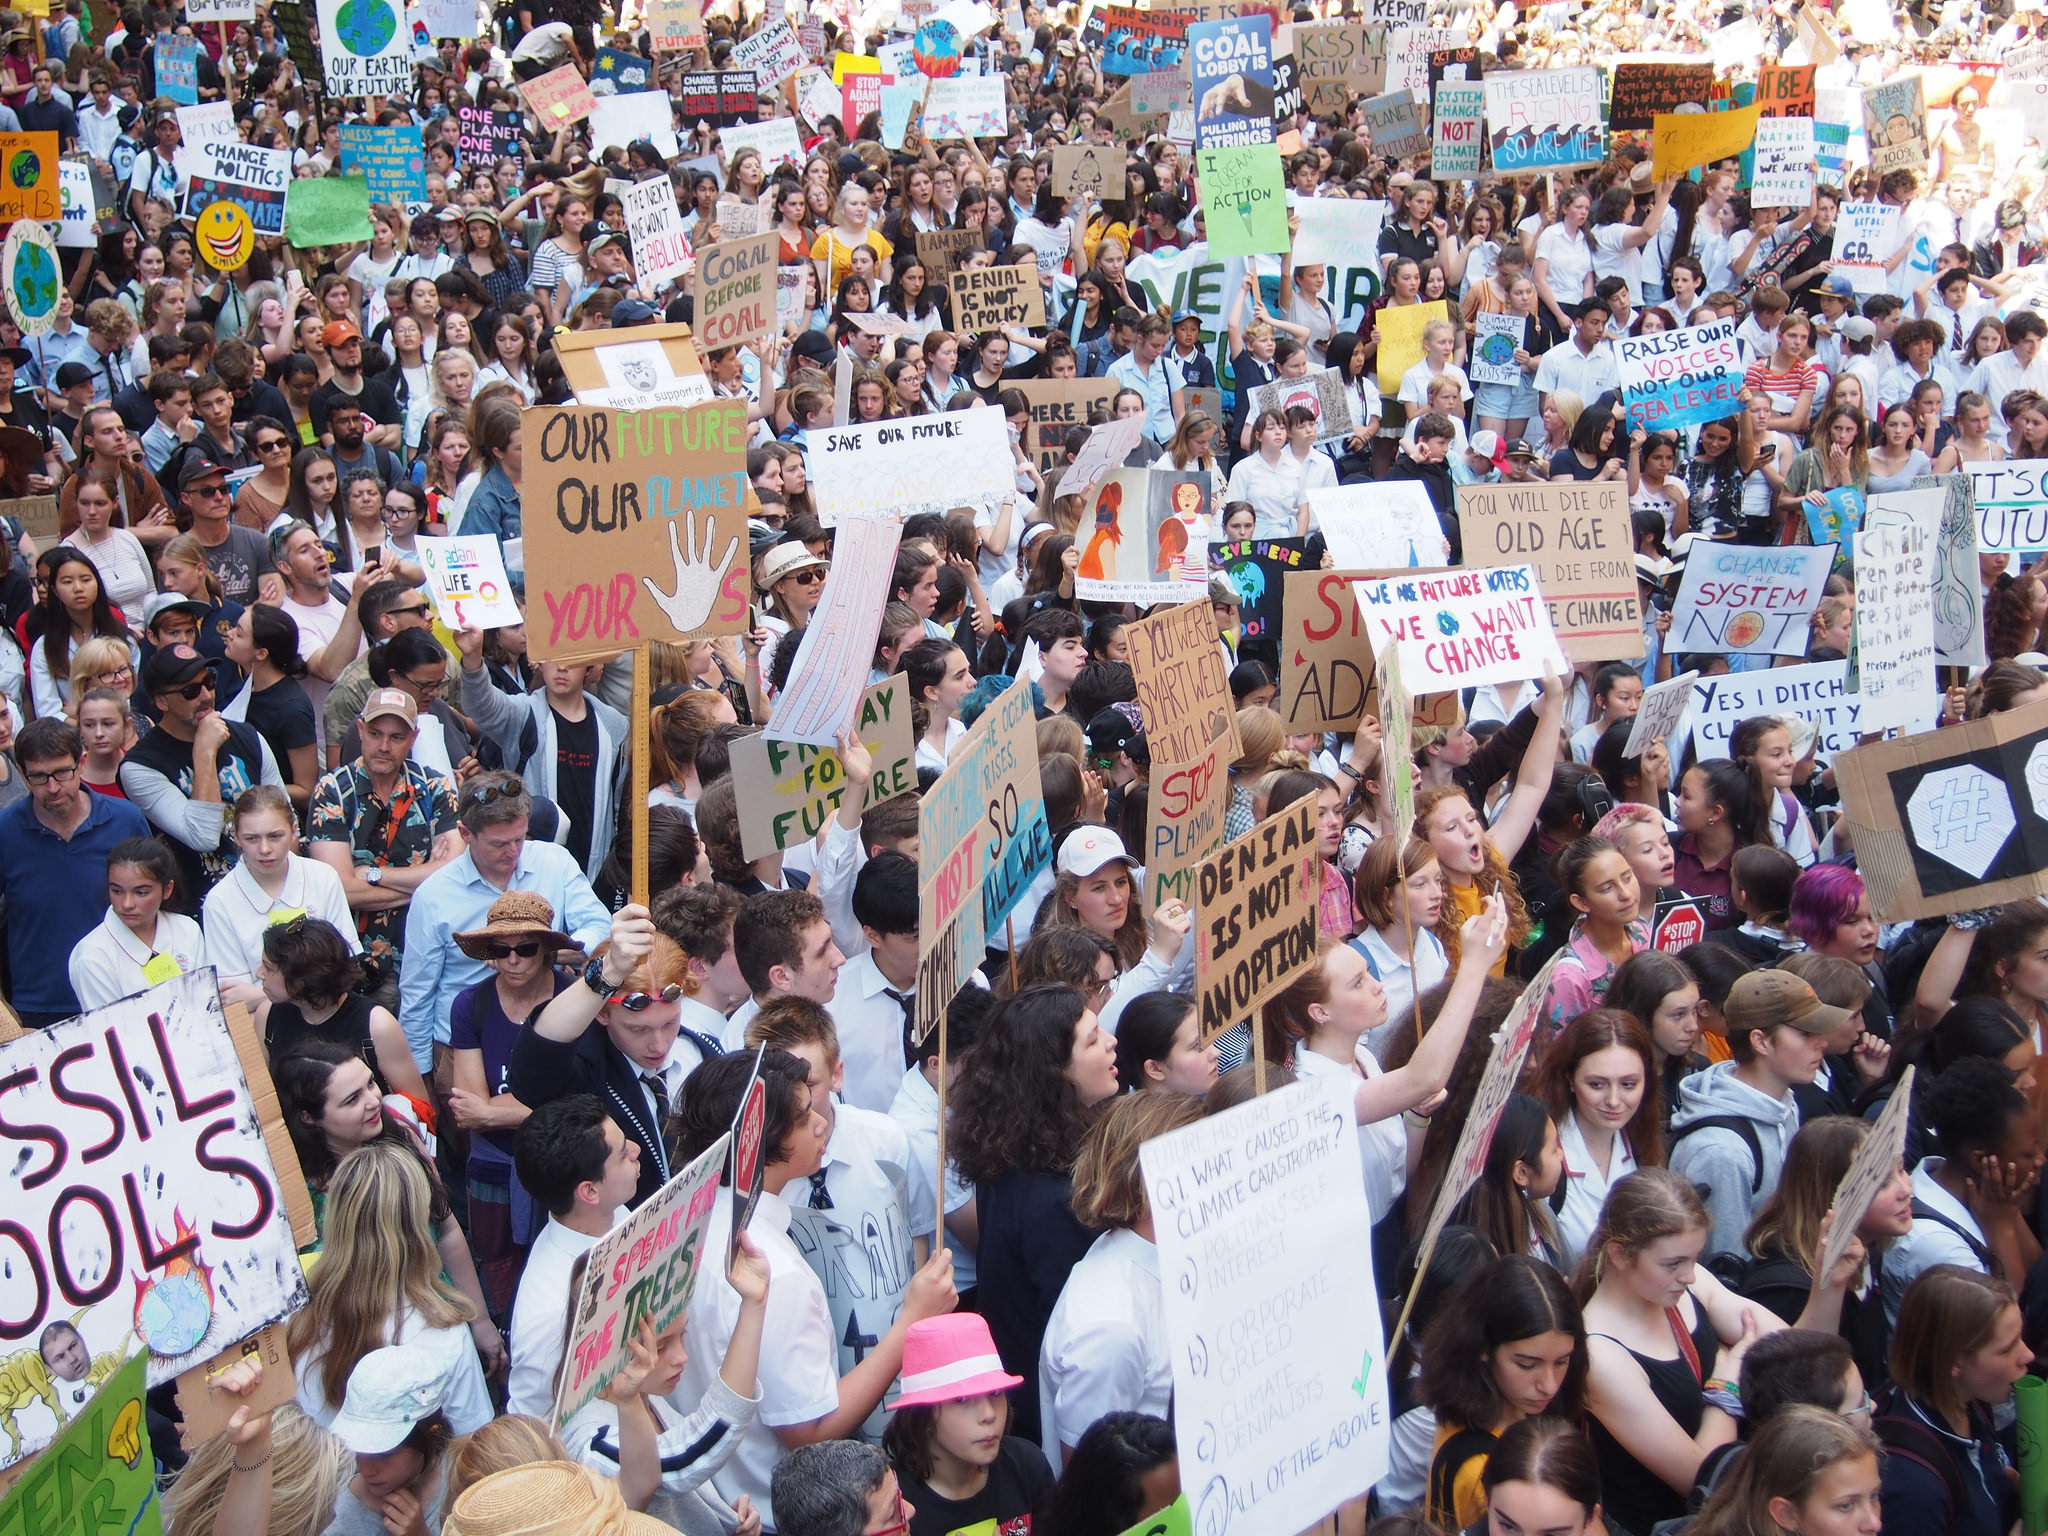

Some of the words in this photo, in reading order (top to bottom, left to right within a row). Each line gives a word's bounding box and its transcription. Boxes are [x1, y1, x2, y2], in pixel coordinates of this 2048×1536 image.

[1111, 6, 1135, 19] The
[1374, 0, 1427, 22] REPORT
[736, 38, 761, 61] SHUT
[762, 20, 789, 42] DOWN
[1109, 22, 1156, 48] rising
[1221, 23, 1239, 34] THE
[656, 34, 703, 49] FUTURE
[1106, 39, 1127, 56] so
[1132, 44, 1162, 64] are
[1195, 32, 1267, 62] COAL
[1301, 31, 1354, 59] KISS
[1362, 28, 1386, 51] MY
[333, 57, 357, 75] OUR
[366, 54, 411, 75] EARTH
[762, 51, 783, 68] NOT
[1197, 59, 1248, 78] LOBBY
[1253, 55, 1268, 70] IS
[1619, 64, 1661, 79] Scott
[327, 78, 353, 97] OUR
[359, 77, 411, 94] FUTURE
[683, 85, 718, 95] POLITICS
[684, 75, 716, 85] CHANGE
[721, 82, 756, 93] POLITICS
[722, 74, 754, 83] CHANGE
[856, 77, 881, 89] STOP
[1878, 83, 1905, 97] REAL
[1311, 83, 1345, 105] ASS
[1436, 91, 1482, 103] SYSTEM
[458, 107, 493, 124] ONE
[1367, 103, 1415, 128] PLANET
[1435, 104, 1480, 117] CHANGE
[1510, 95, 1591, 126] RISING
[340, 128, 373, 142] UNLESS
[460, 123, 521, 141] PLANET
[1201, 120, 1247, 136] PULLING
[1249, 116, 1271, 129] THE
[459, 136, 492, 152] ONE
[1202, 130, 1271, 150] STRINGS
[1433, 145, 1479, 158] CLIMATE
[1505, 137, 1527, 163] SO
[1533, 132, 1563, 161] ARE
[1570, 130, 1599, 160] WE
[204, 143, 270, 167] CHANGE
[1433, 159, 1477, 171] CHANGE
[1884, 146, 1915, 163] 100%
[1783, 163, 1810, 172] NEED
[1754, 180, 1805, 189] MOTHER
[34, 189, 54, 217] B
[1213, 189, 1271, 210] ACTION
[703, 242, 770, 286] CORAL
[954, 269, 1027, 291] DENIAL
[704, 273, 761, 316] BEFORE
[960, 293, 979, 310] IS
[983, 288, 1018, 307] NOT
[703, 302, 767, 346] COAL
[961, 313, 974, 329] A
[977, 303, 1029, 327] POLICY
[1478, 315, 1521, 326] CLIMATE
[1484, 324, 1514, 333] CHANGE
[1621, 332, 1690, 363] RAISE
[1697, 324, 1735, 343] OUR
[1471, 362, 1500, 380] EXISTS
[1643, 342, 1735, 379] VOICES
[1628, 376, 1668, 398] NOT
[1679, 364, 1728, 388] OUR
[608, 391, 634, 407] Here
[636, 390, 648, 403] in
[654, 385, 693, 402] support
[695, 384, 705, 395] of
[1629, 401, 1669, 424] SEA
[1672, 381, 1741, 410] LEVEL
[541, 412, 610, 463] OUR
[616, 409, 746, 459] FUTURE
[826, 434, 862, 452] SAVE
[878, 427, 904, 444] OUR
[912, 420, 963, 440] FUTURE
[557, 478, 642, 534] OUR
[647, 472, 747, 519] PLANET
[1461, 493, 1497, 517] YOU
[1508, 492, 1549, 512] WILL
[1559, 491, 1590, 511] DIE
[1600, 491, 1616, 510] OF
[1496, 521, 1545, 554] OLD
[1558, 517, 1606, 550] AGE
[443, 547, 477, 564] adani
[1212, 541, 1252, 565] LIVE
[1257, 542, 1302, 566] HERE
[1717, 553, 1806, 575] CHANGE
[443, 573, 471, 592] LIFE
[1556, 563, 1581, 581] DIE
[1590, 561, 1630, 579] FROM
[1745, 575, 1774, 584] THE
[1364, 583, 1392, 604] WE
[1396, 582, 1417, 602] ARE
[1419, 574, 1482, 602] FUTURE
[1484, 568, 1529, 593] VOTERS
[1695, 582, 1808, 609] SYSTEM
[543, 573, 640, 646] YOUR
[720, 567, 748, 622] S
[1566, 599, 1637, 627] CHANGE
[1380, 616, 1425, 642] WE
[1472, 597, 1537, 636] WANT
[1682, 609, 1809, 649] NOT
[1127, 627, 1140, 675] IF
[1144, 615, 1174, 668] YOU
[1172, 599, 1220, 651] WERE
[1860, 630, 1892, 649] burn
[1425, 634, 1520, 676] CHANGE
[1693, 681, 1745, 714] YES
[1757, 689, 1763, 706] I
[1161, 752, 1215, 819] STOP
[988, 782, 1019, 861] SO
[1155, 799, 1215, 858] PLAYING
[1018, 817, 1049, 878] WE
[1200, 806, 1315, 907] DENIAL
[935, 828, 977, 931] NOT
[1211, 903, 1242, 961] IS
[1249, 863, 1295, 930] NOT
[1664, 920, 1696, 939] #STOP
[1202, 974, 1232, 1038] AN
[1234, 904, 1316, 1009] OPTION
[1192, 1148, 1233, 1187] WHAT
[1245, 1116, 1299, 1161] CAUSED
[1305, 1102, 1331, 1129] THE
[1177, 1179, 1246, 1239] CLIMATE
[1249, 1113, 1343, 1194] CATASTROPHY?
[573, 1311, 619, 1392] THE
[620, 1227, 700, 1349] TREES
[1217, 1265, 1331, 1356] CORPORATE
[1220, 1324, 1293, 1386] GREED
[1228, 1480, 1261, 1524] ALL
[1266, 1457, 1288, 1494] OF
[1292, 1438, 1324, 1477] THE
[1327, 1401, 1380, 1455] ABOVE
